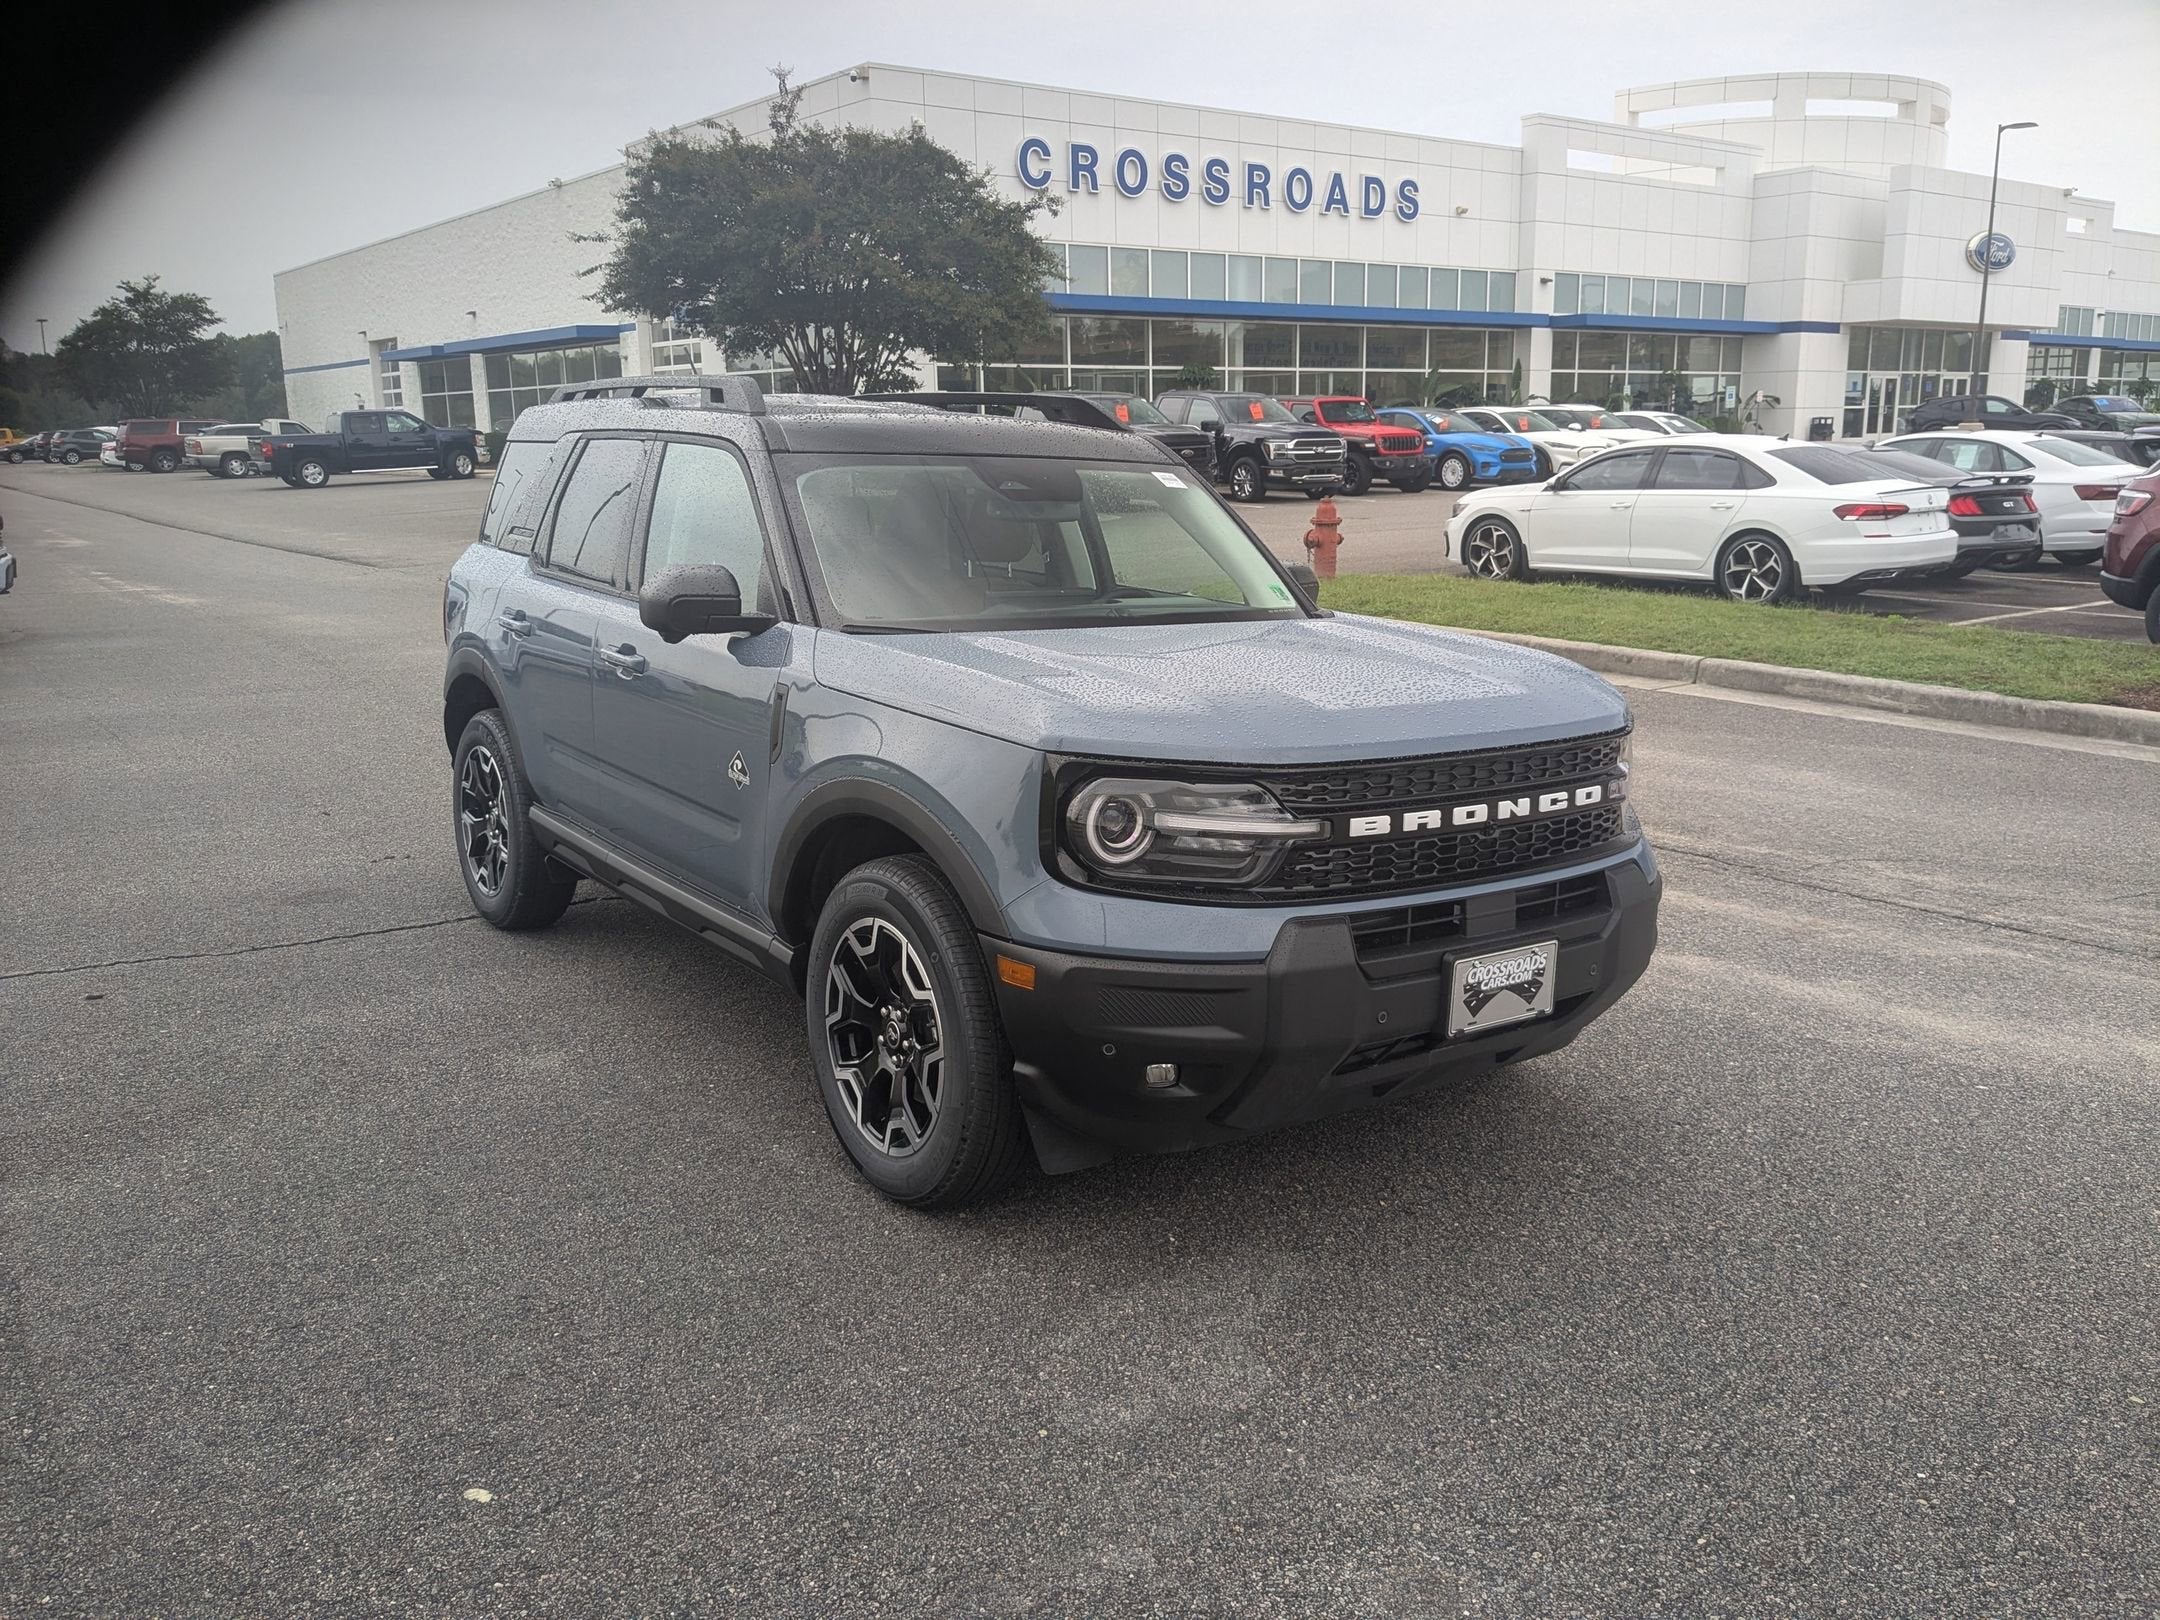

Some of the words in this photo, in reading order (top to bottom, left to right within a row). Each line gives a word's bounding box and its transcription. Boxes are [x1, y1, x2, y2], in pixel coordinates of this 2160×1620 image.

[1016, 136, 1421, 223] CROSSROADS
[1348, 785, 1602, 838] BRONCO
[1466, 952, 1549, 984] CROSSROADS
[1480, 969, 1533, 991] CARS.COM
